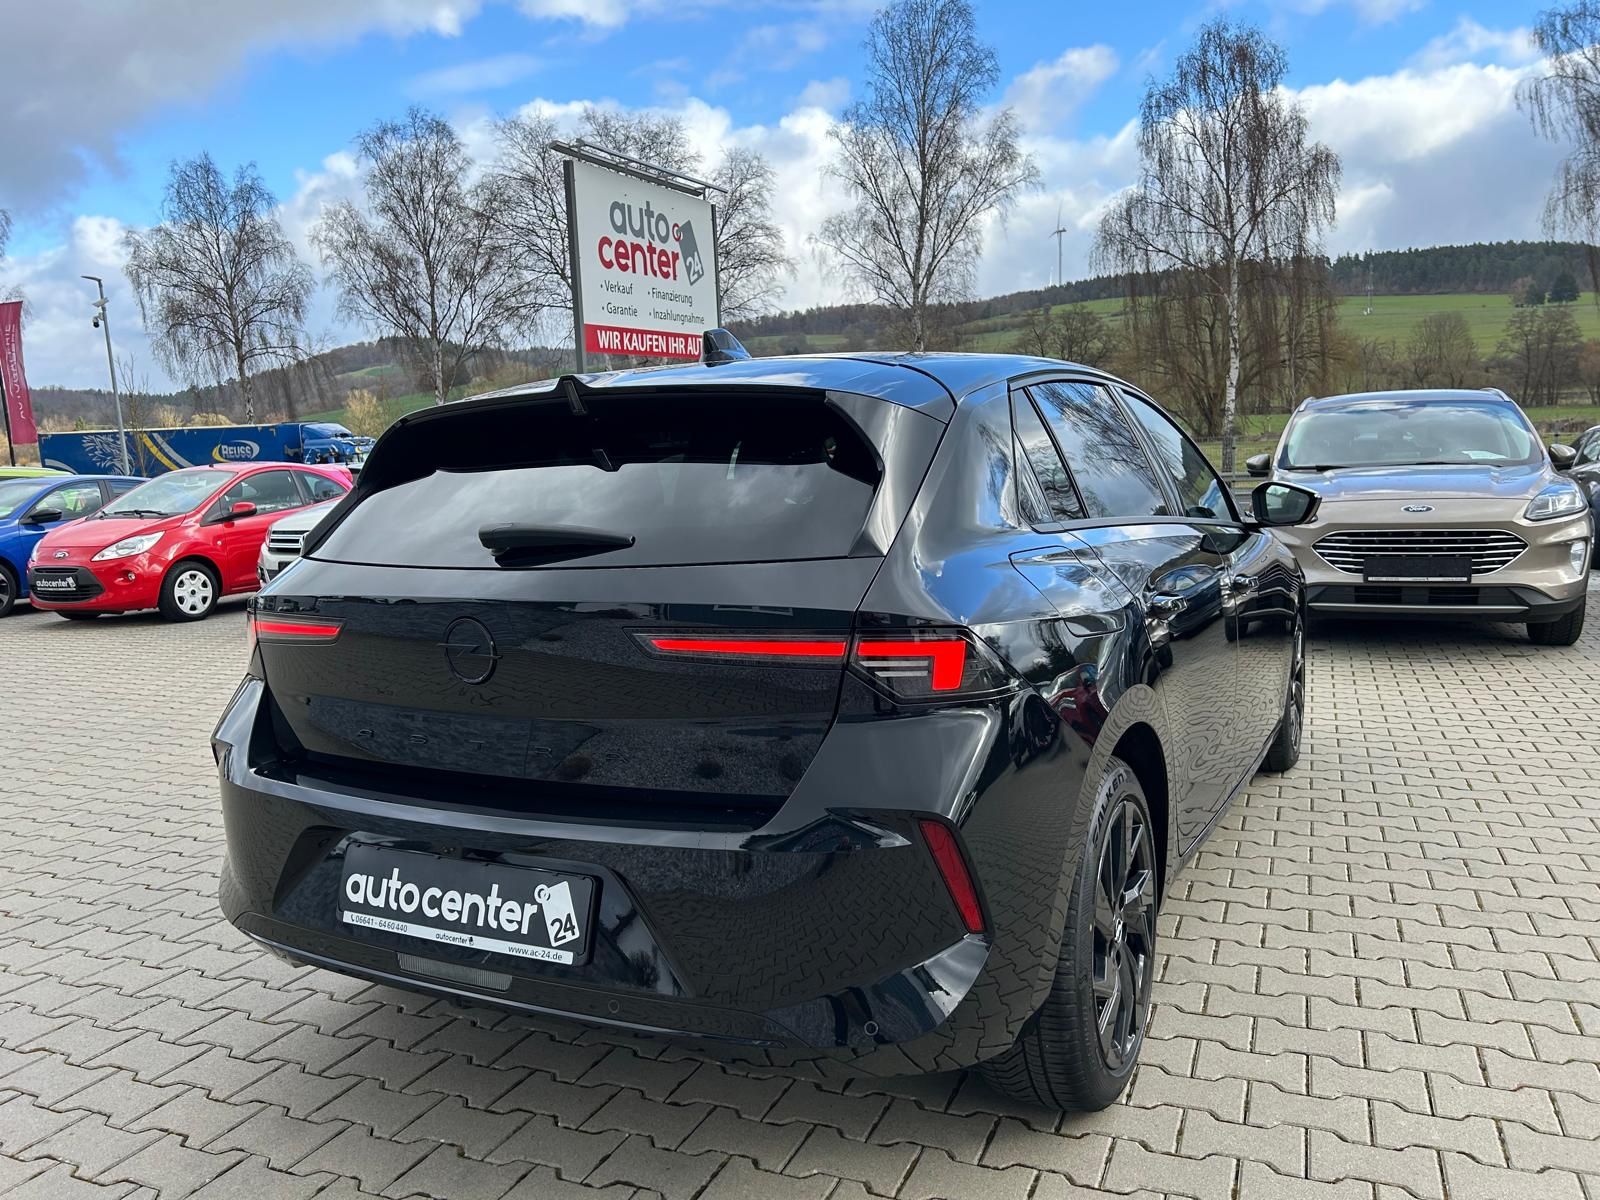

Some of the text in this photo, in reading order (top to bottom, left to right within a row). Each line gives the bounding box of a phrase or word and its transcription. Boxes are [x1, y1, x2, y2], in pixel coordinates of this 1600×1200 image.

[609, 200, 670, 244] auto
[598, 236, 680, 281] center
[686, 251, 703, 281] 24
[605, 280, 633, 295] Verkauf
[651, 288, 693, 307] Finanzierung
[606, 302, 638, 317] Garantie
[653, 308, 705, 325] Inzahlungnahme
[597, 330, 622, 349] WIR
[623, 332, 667, 353] KAUFEN
[668, 336, 686, 355] IHR
[221, 444, 253, 459] REUSS
[36, 578, 68, 588] autocenter
[356, 728, 630, 764] ASTRA
[345, 867, 538, 935] autocenter
[550, 913, 576, 943] 24
[435, 933, 468, 945] autocenter
[508, 946, 563, 961] www.ac-24.de
